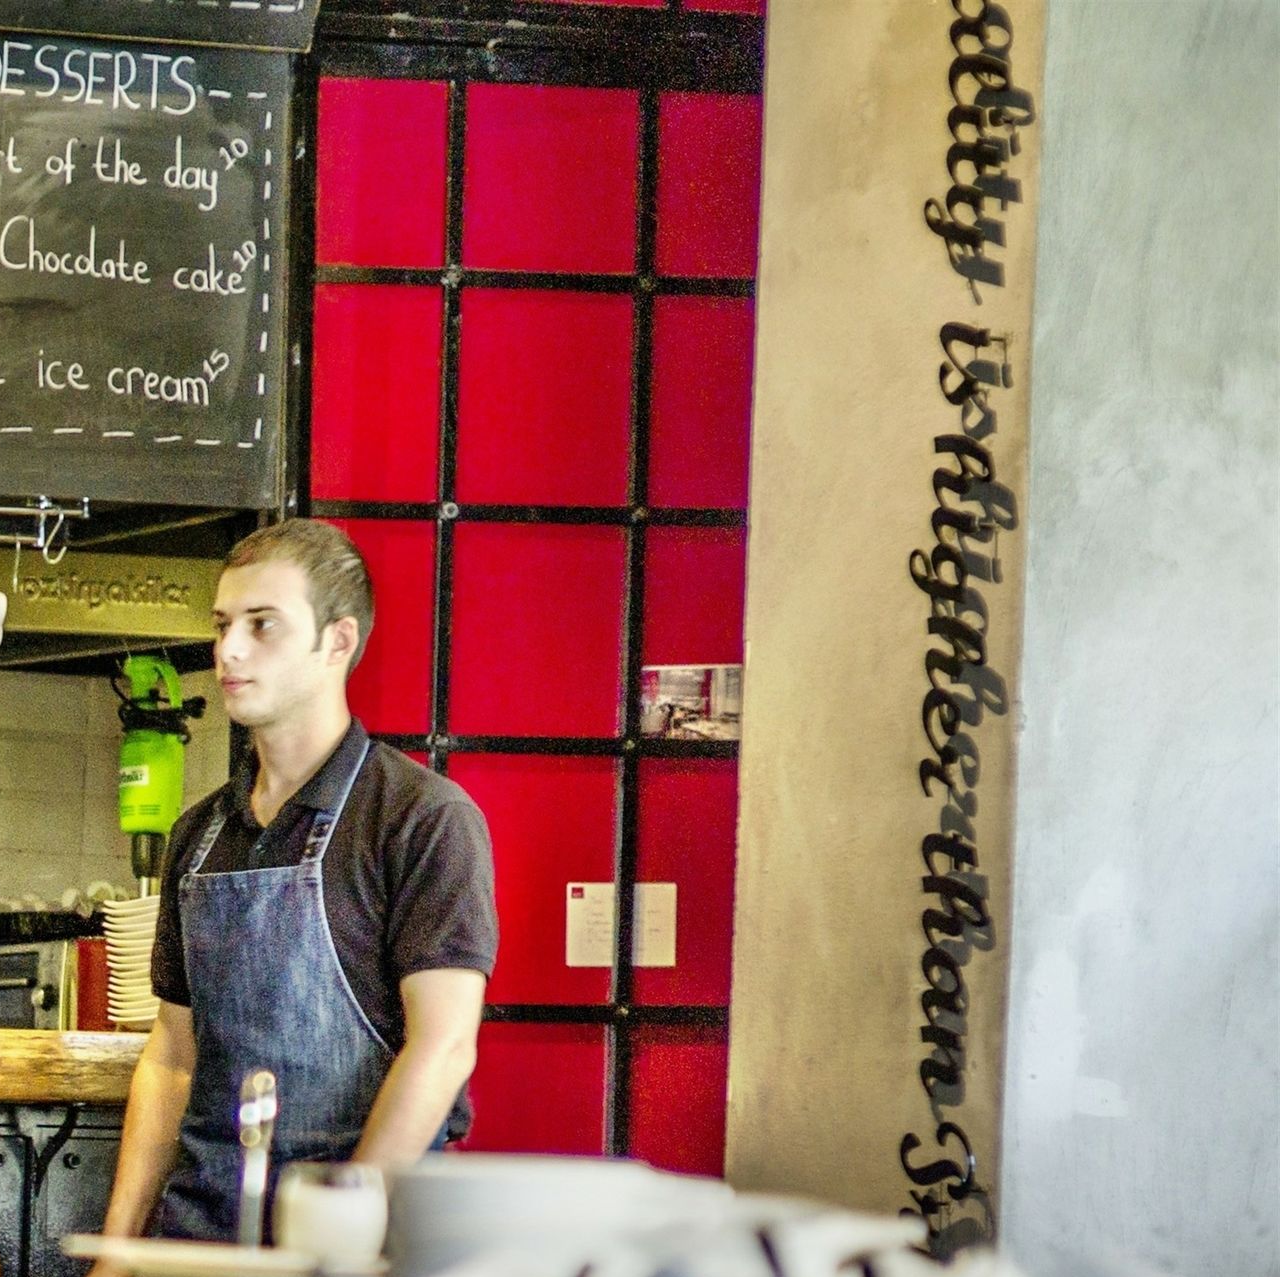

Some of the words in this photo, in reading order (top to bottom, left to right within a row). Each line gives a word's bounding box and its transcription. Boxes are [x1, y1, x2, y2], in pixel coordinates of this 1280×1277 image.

[45, 137, 79, 185] of
[93, 137, 147, 186] the
[163, 135, 218, 212] day
[0, 215, 151, 284] Chocolate
[173, 243, 246, 295] cake
[38, 350, 89, 389] ice
[107, 366, 210, 406] cream
[940, 320, 992, 406] is
[908, 433, 996, 797] higher
[920, 832, 990, 1100] than
